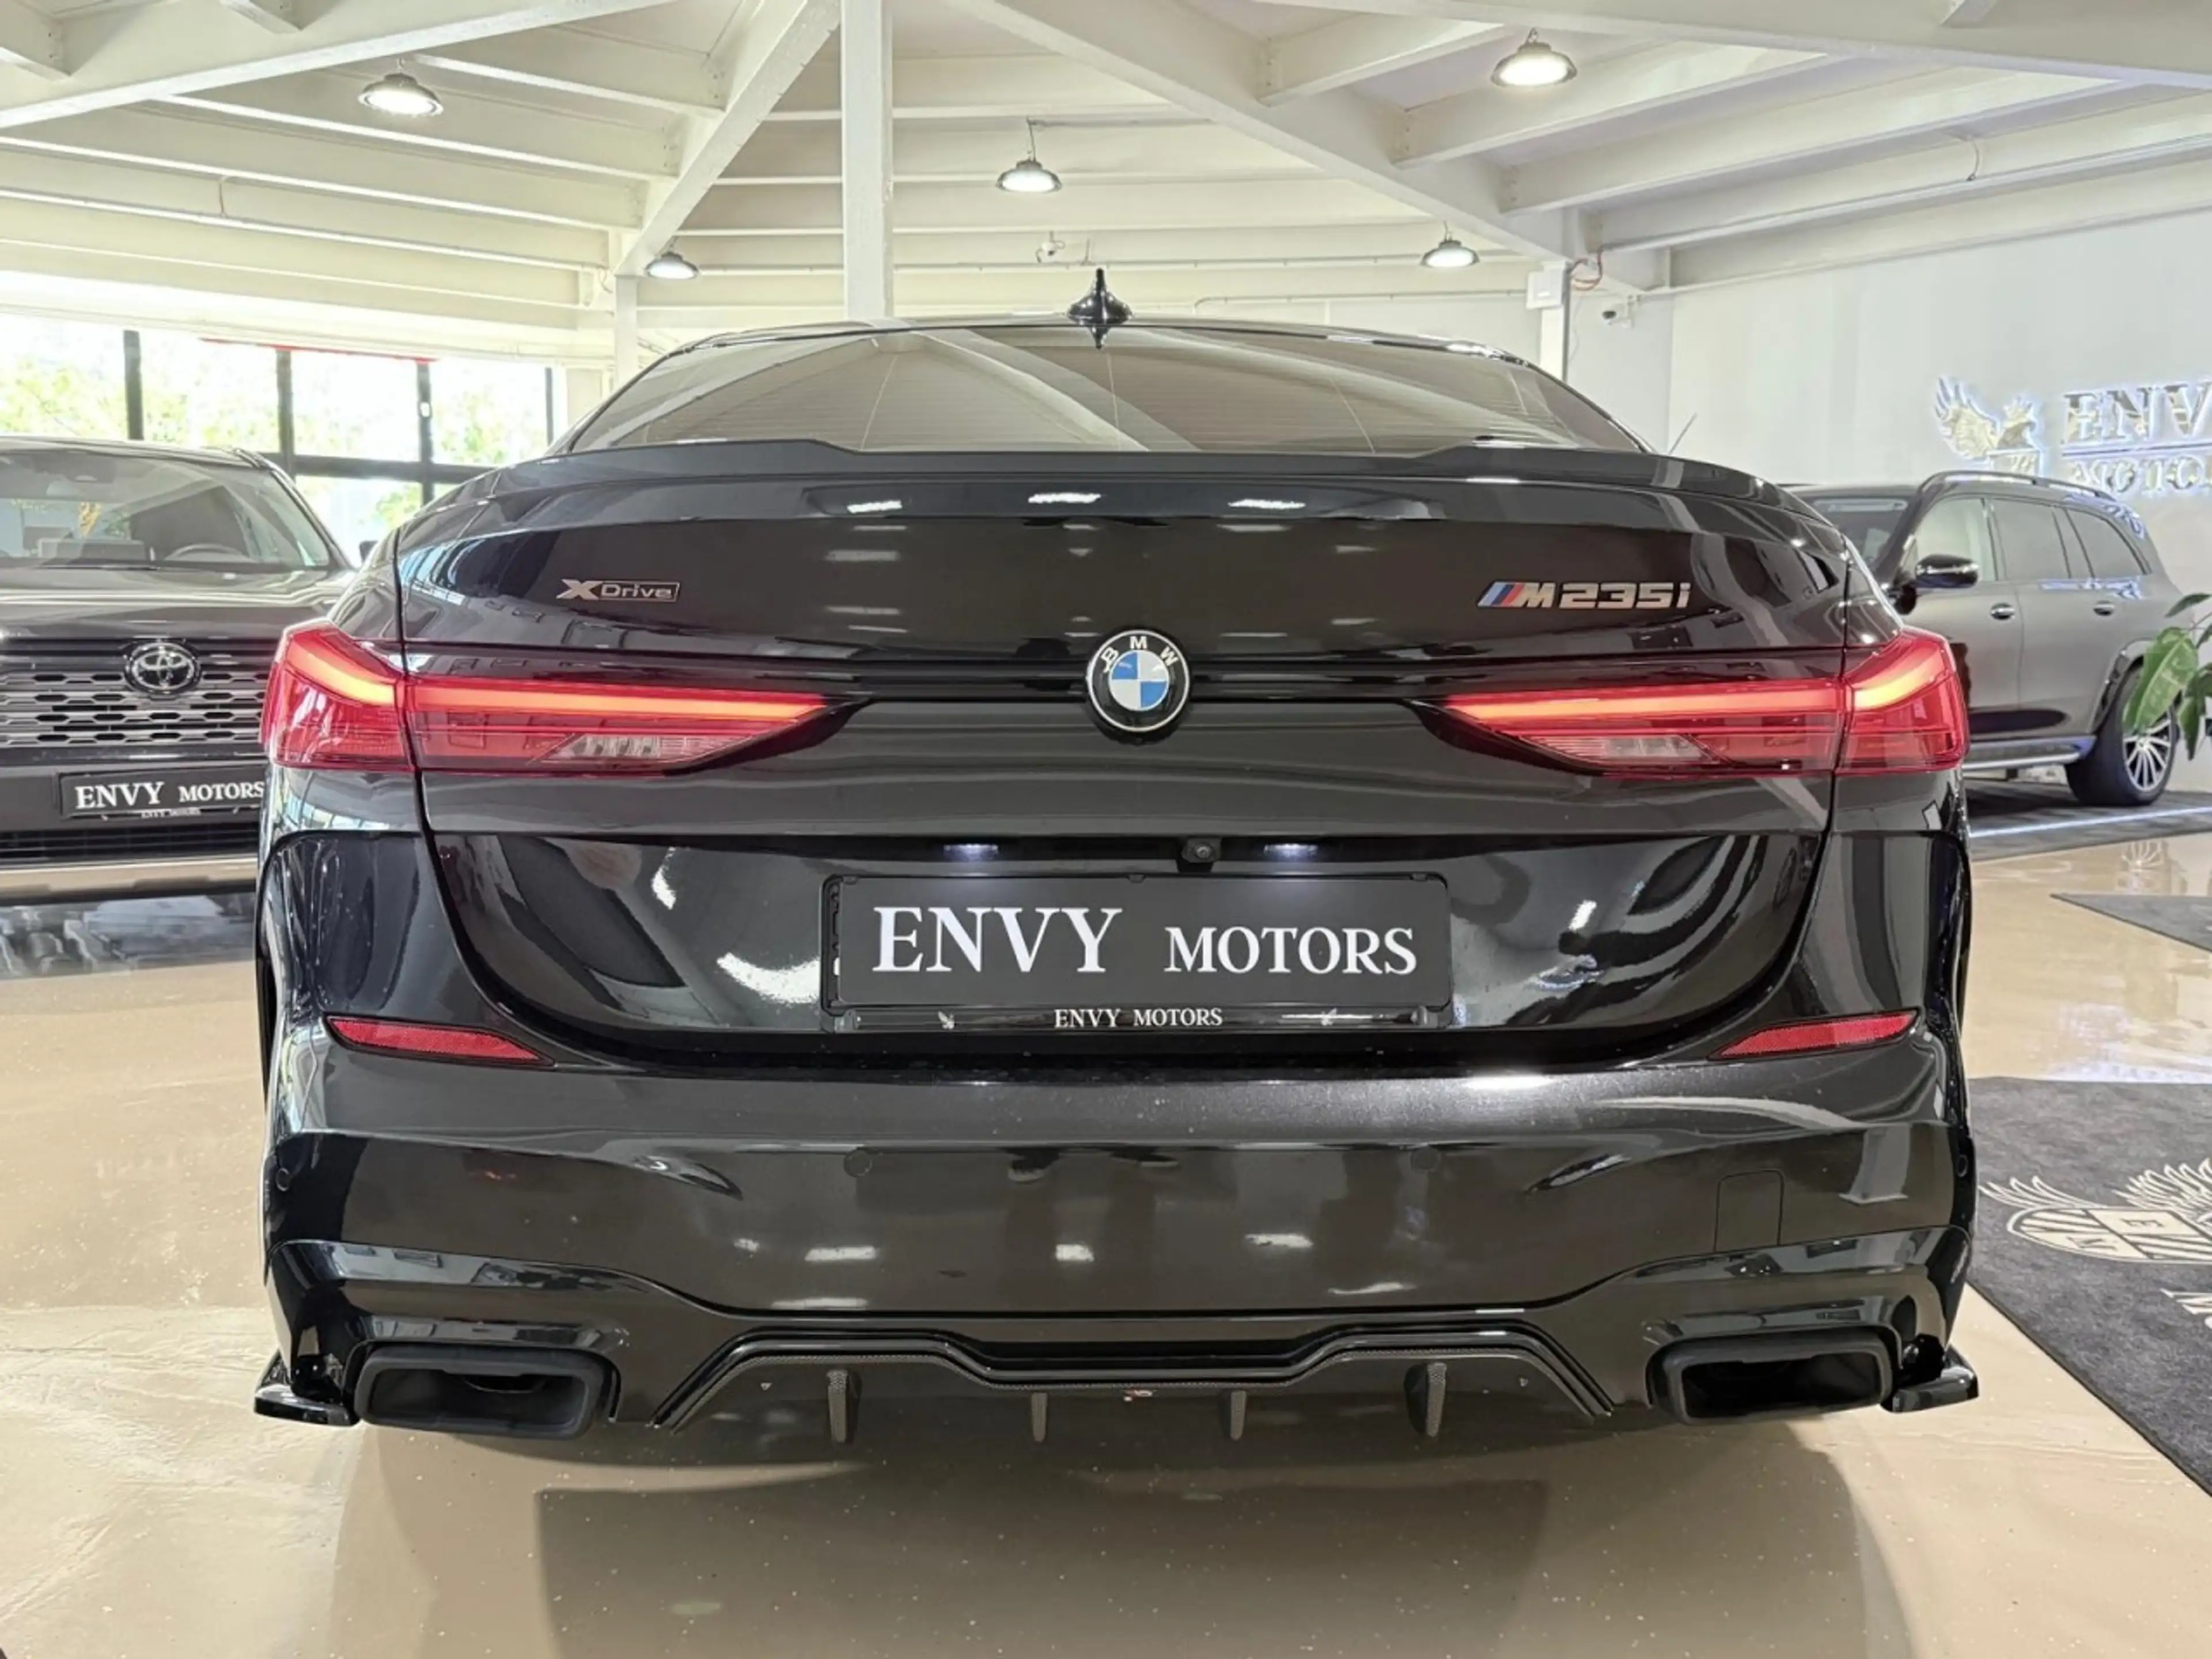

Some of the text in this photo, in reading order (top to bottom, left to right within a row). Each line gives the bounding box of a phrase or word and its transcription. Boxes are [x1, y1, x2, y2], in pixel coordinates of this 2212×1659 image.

[2069, 454, 2212, 494] MOTO
[1513, 582, 1691, 608] M235i
[1101, 636, 1179, 674] BMW
[75, 781, 266, 809] ENVY MOTORS
[872, 907, 1417, 975] ENVY MOTORS
[1054, 1007, 1223, 1028] ENVY MOTORS
